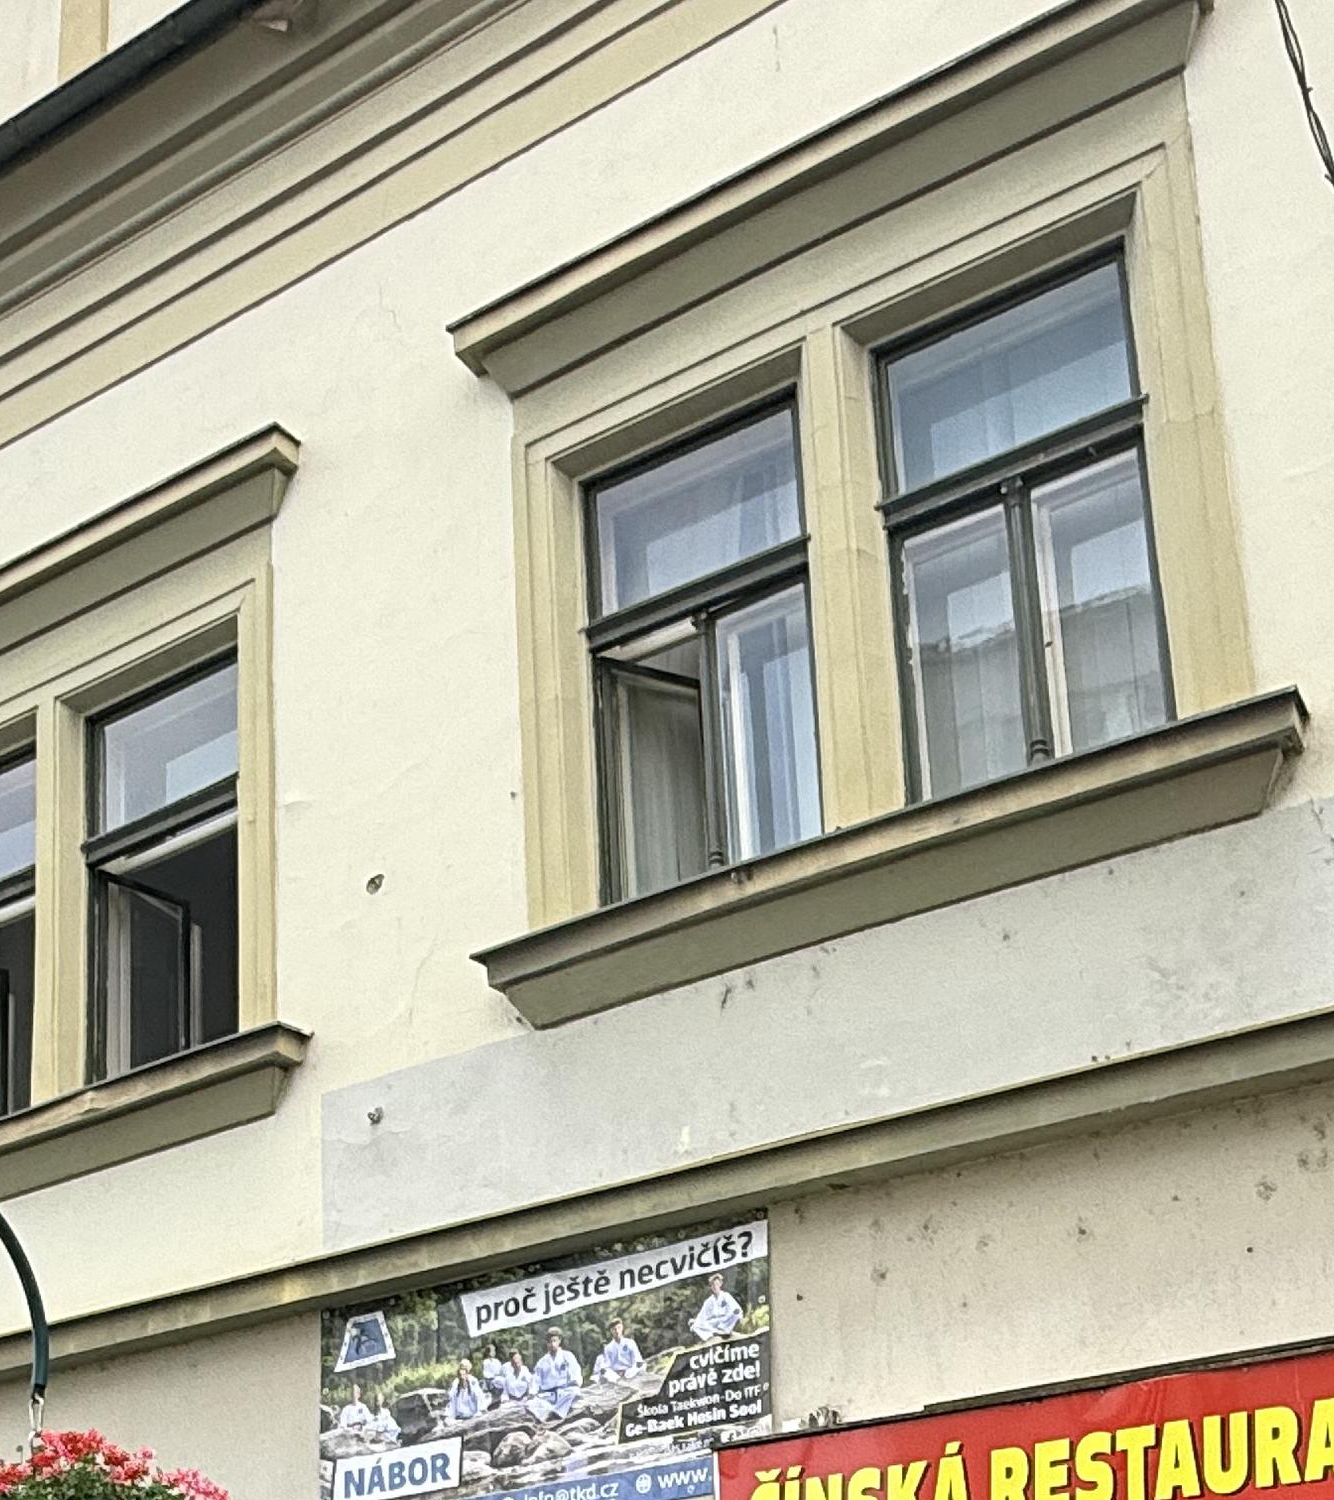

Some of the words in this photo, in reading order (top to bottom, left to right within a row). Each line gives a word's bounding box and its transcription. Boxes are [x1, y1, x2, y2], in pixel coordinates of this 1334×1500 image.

[475, 1286, 537, 1330] proč
[543, 1270, 611, 1315] ještě
[619, 1230, 754, 1290] necvičíš?
[689, 1343, 760, 1369] cvičíme
[669, 1368, 717, 1398] právě
[343, 1451, 452, 1499] NÁBOR
